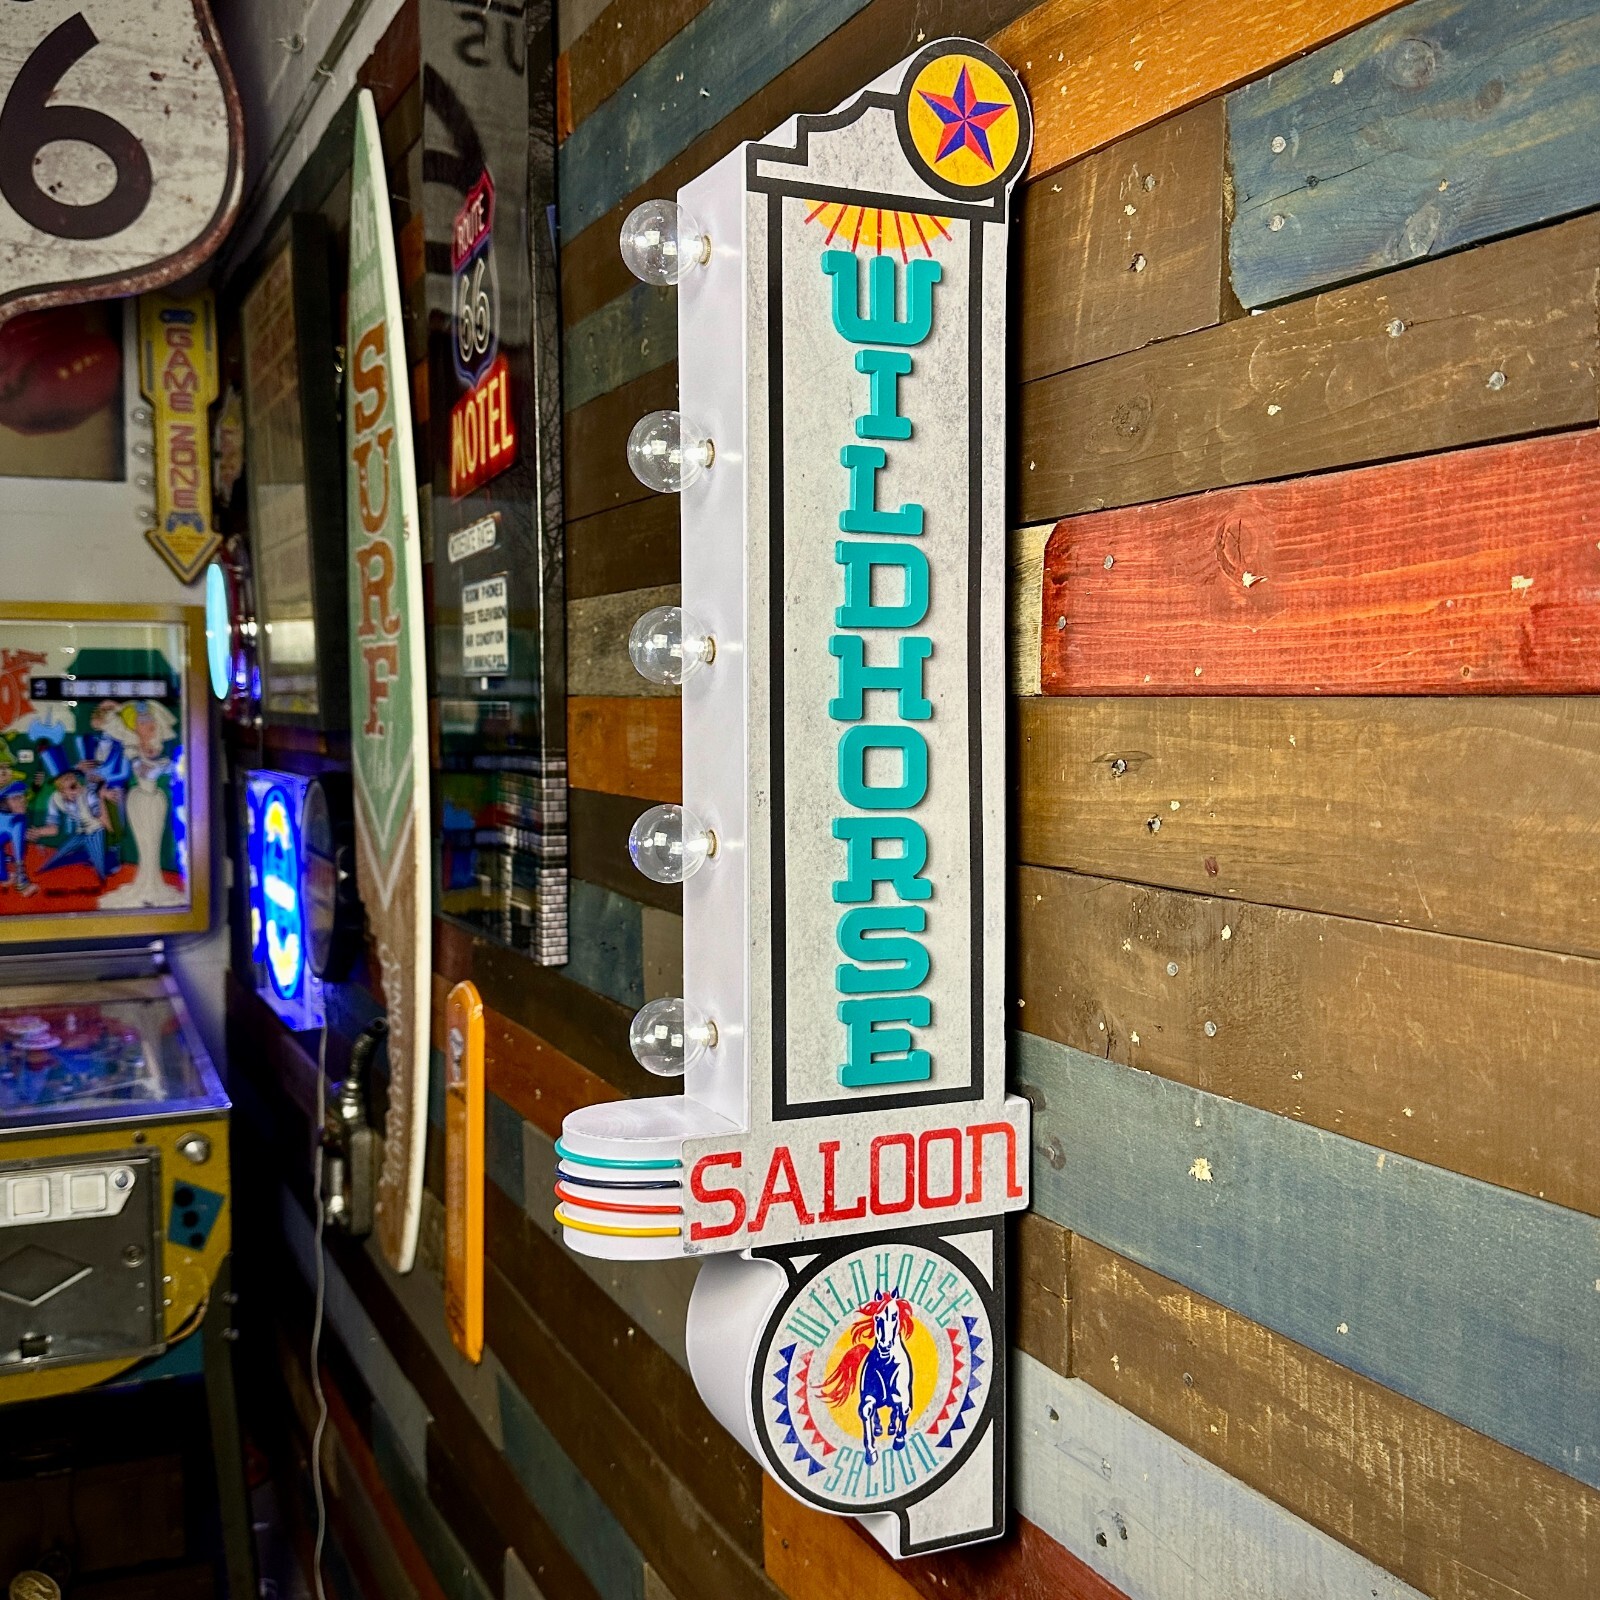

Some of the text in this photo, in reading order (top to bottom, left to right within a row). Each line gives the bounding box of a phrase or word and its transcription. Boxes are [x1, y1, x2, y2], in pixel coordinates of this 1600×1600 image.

[457, 193, 485, 259] ROUTE
[459, 258, 491, 362] 66
[163, 326, 200, 414] GAME
[168, 424, 201, 510] ZONE
[451, 371, 514, 488] MOTEL
[352, 323, 401, 741] SURF
[822, 249, 941, 1087] WILDHORSE
[689, 1121, 1023, 1242] SALOON
[785, 1252, 974, 1349] WILDHORSE
[822, 1431, 939, 1498] SALOON
